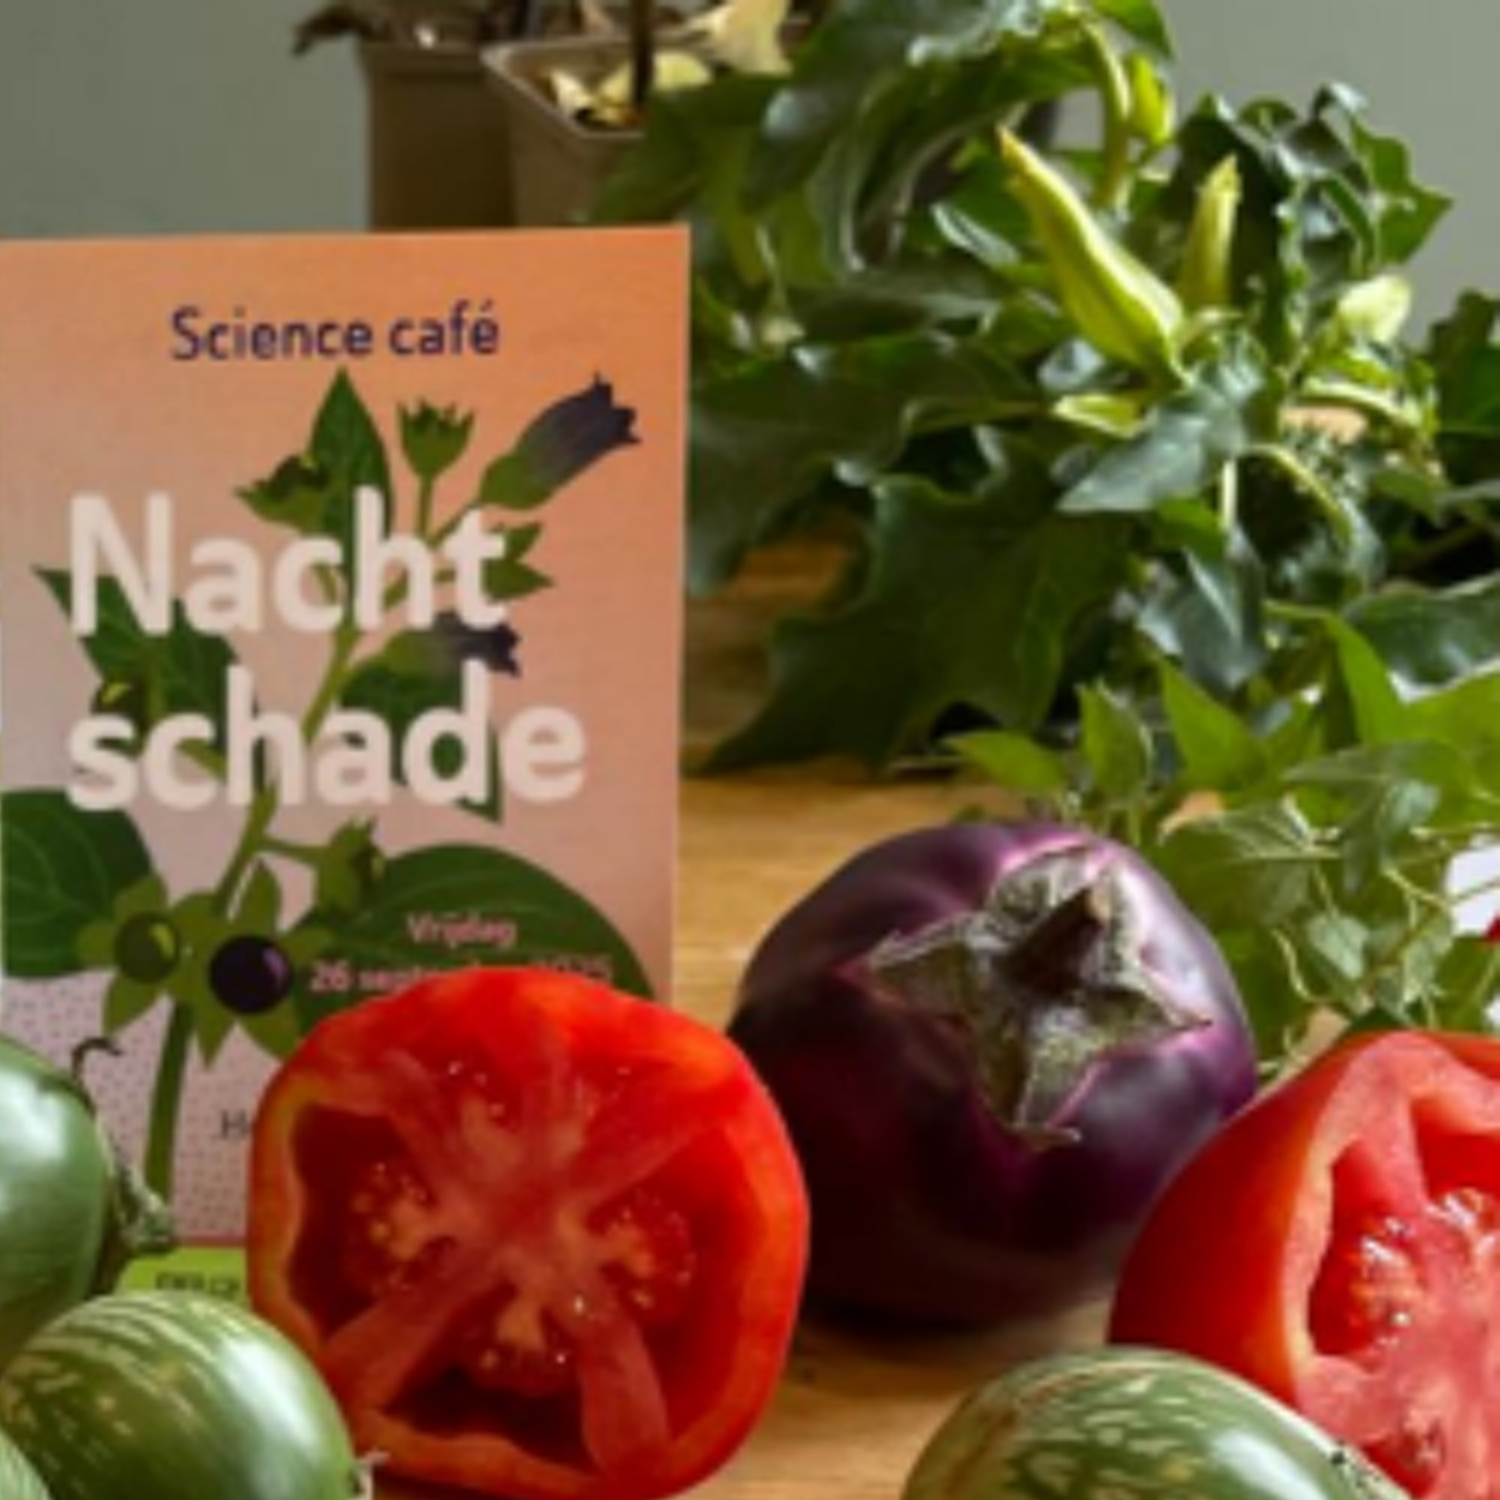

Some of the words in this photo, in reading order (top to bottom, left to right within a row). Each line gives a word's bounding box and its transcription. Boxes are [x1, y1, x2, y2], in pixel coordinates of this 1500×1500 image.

[172, 306, 373, 360] Science
[389, 299, 500, 356] café
[68, 485, 508, 638] Nacht
[63, 658, 587, 812] schade
[408, 912, 517, 951] Vrijdag
[311, 959, 351, 993] 26
